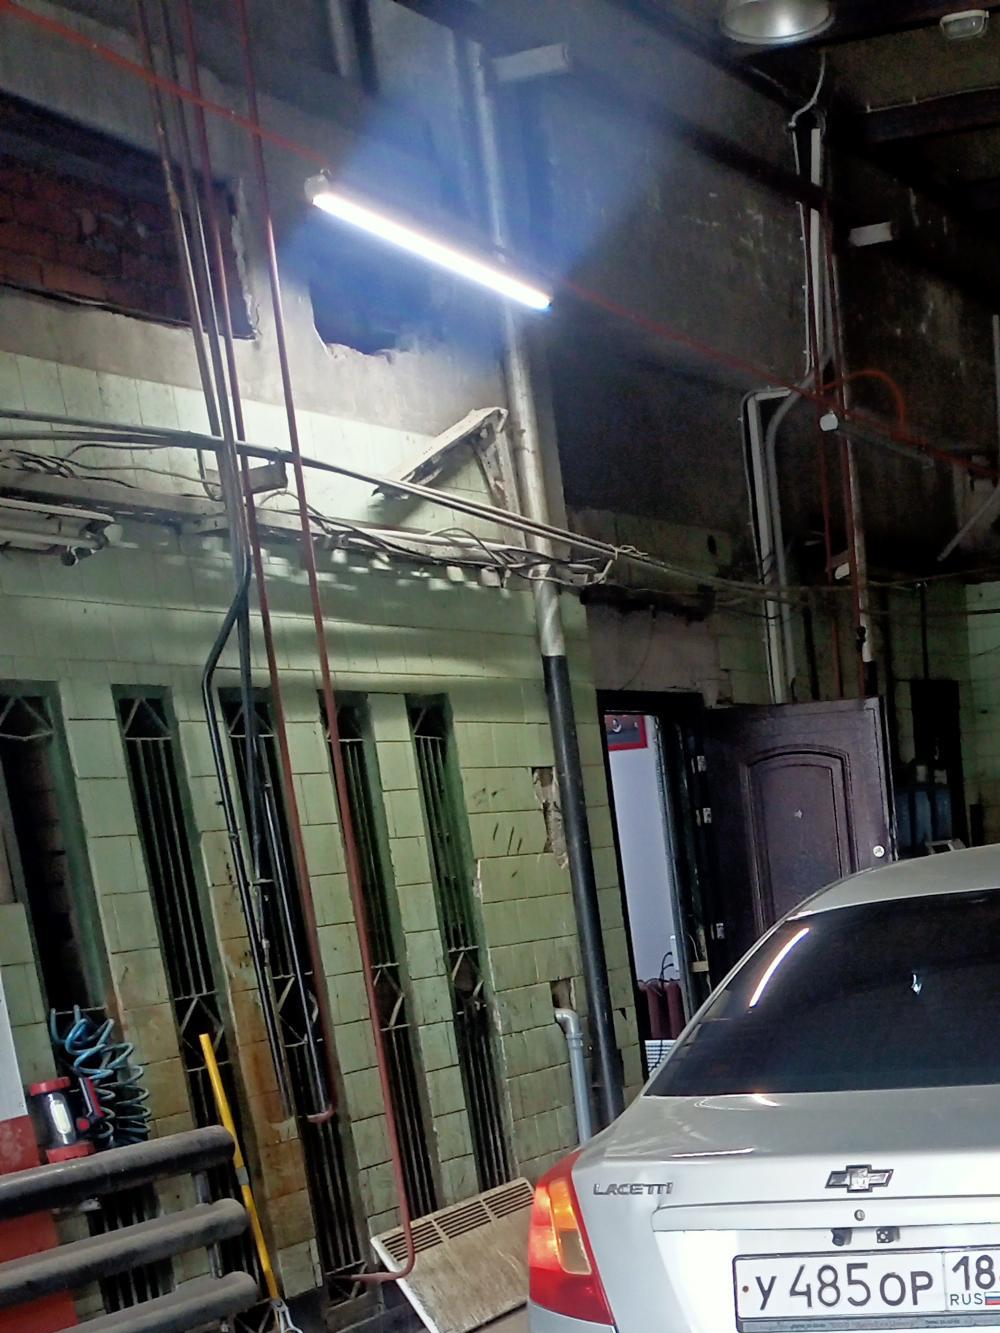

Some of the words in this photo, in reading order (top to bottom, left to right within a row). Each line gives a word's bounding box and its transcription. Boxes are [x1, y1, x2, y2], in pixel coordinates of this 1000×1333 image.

[593, 1182, 674, 1196] LACETTI
[952, 1254, 996, 1291] 18
[949, 1292, 984, 1306] RUS
